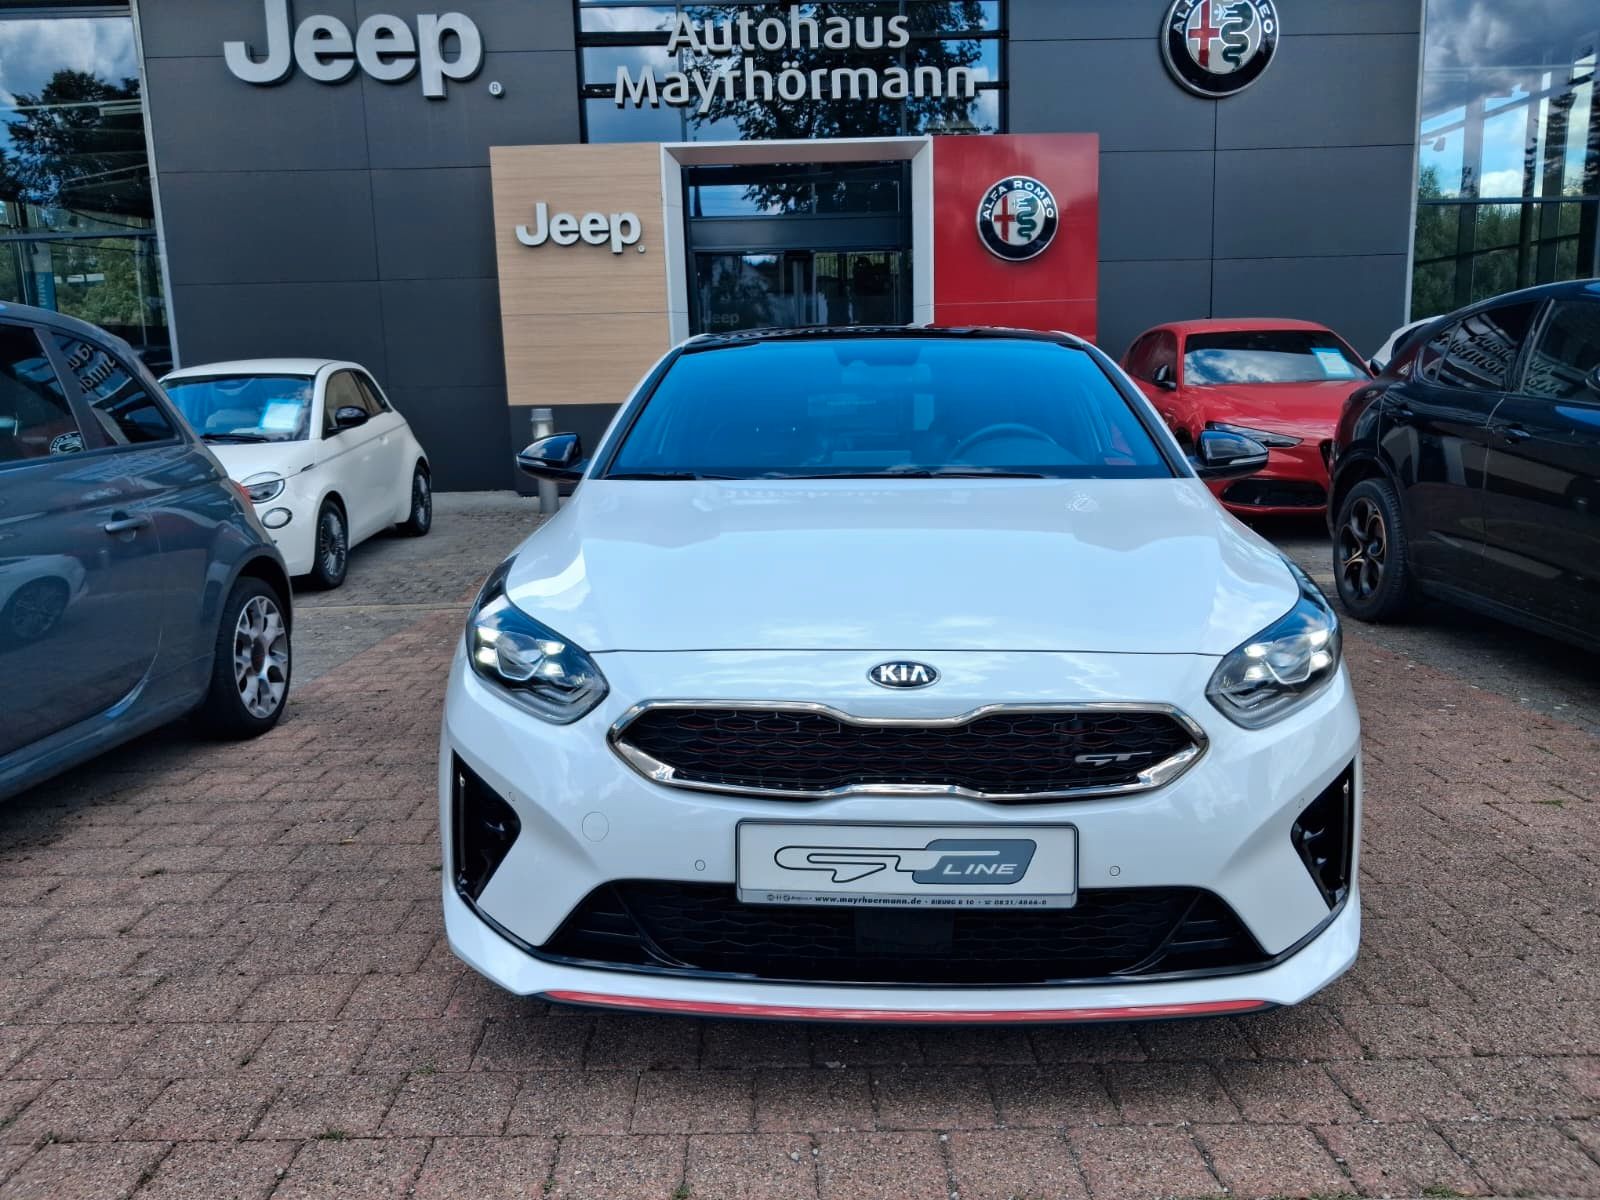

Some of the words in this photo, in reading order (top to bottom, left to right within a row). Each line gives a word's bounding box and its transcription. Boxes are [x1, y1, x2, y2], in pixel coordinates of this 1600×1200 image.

[667, 4, 910, 54] Autohaus
[223, 0, 484, 98] Jeep
[614, 57, 975, 113] Mayrhörmann
[983, 186, 1008, 219] ALFA
[1013, 180, 1054, 218] ROMEO
[515, 201, 642, 253] Jeep
[880, 664, 929, 682] KIA
[1075, 751, 1152, 767] GT
[943, 863, 1019, 876] LINE
[815, 894, 922, 905] www.mayrhoermann.de
